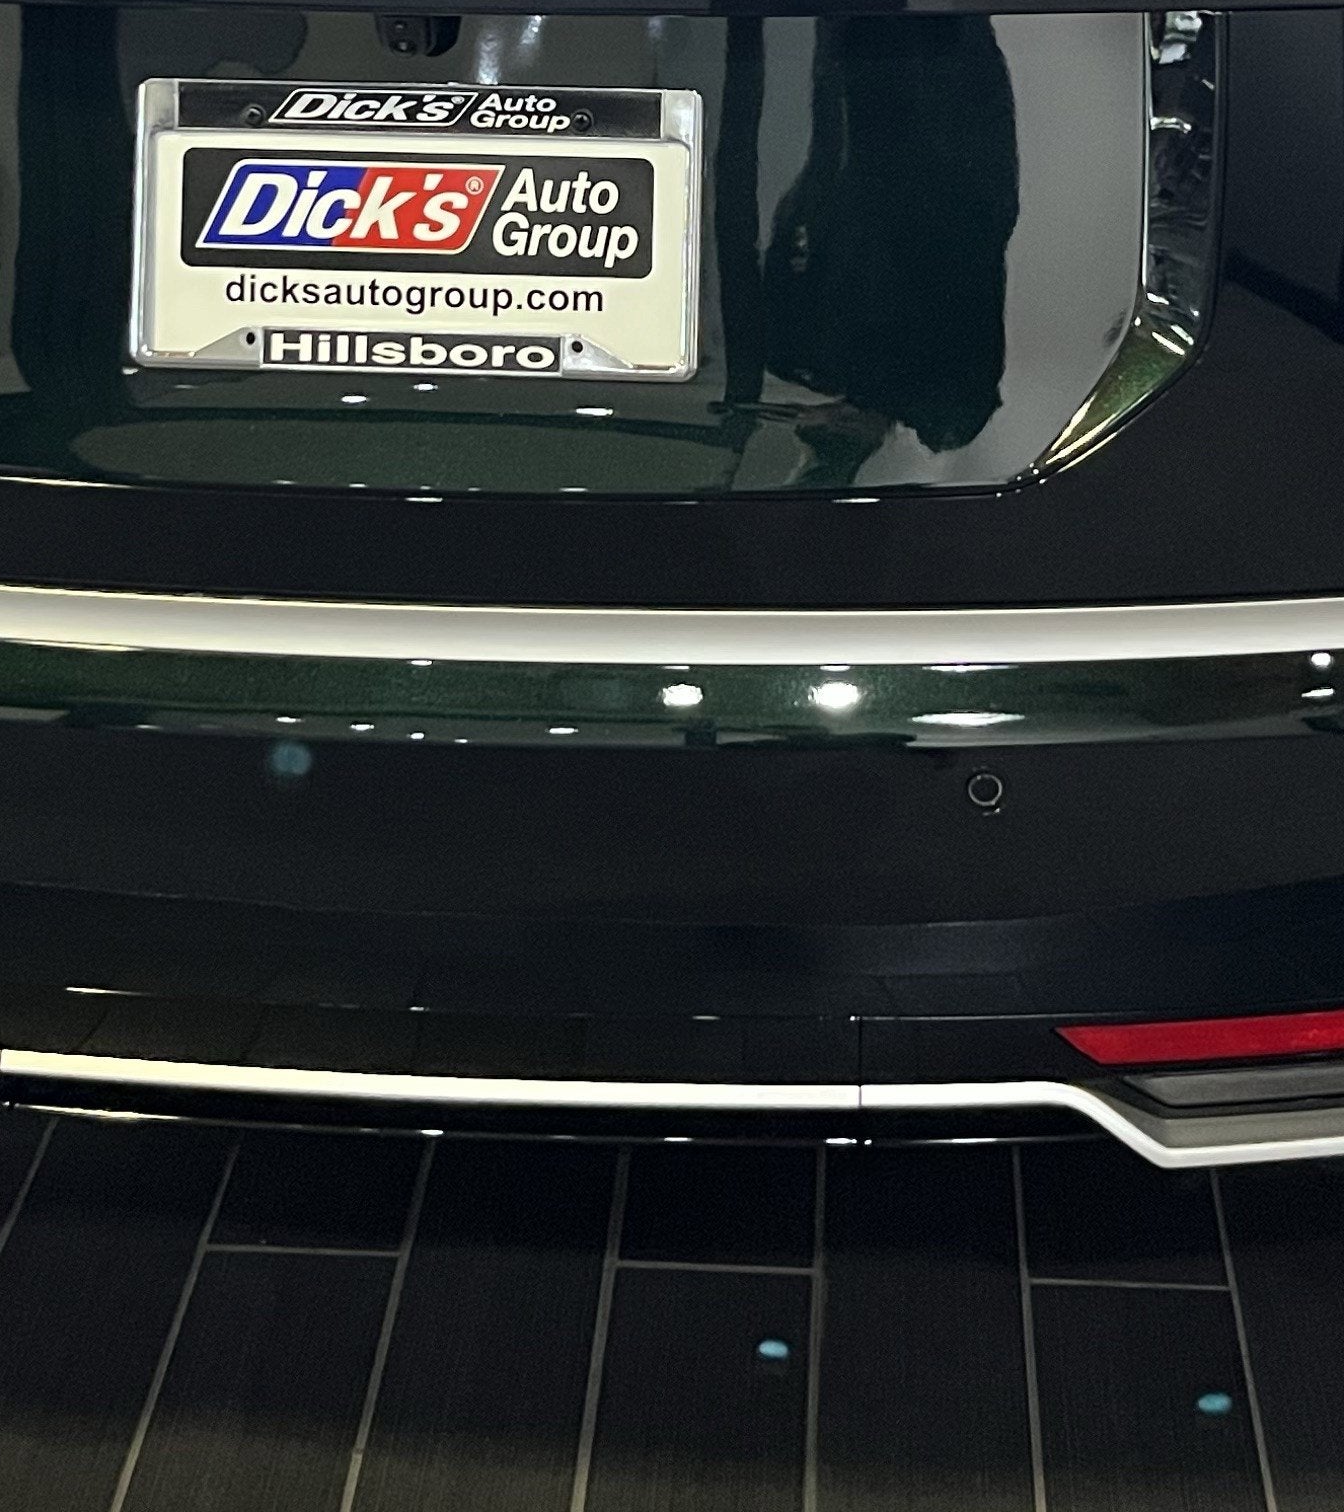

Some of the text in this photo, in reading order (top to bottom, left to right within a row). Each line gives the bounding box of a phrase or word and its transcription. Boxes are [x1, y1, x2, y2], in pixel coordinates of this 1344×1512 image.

[469, 109, 571, 133] Group
[478, 93, 557, 112] Auto
[500, 167, 620, 214] Auto
[491, 214, 639, 268] Group
[225, 274, 604, 315] dicksautogroup.com
[268, 332, 556, 369] Hillsboro
